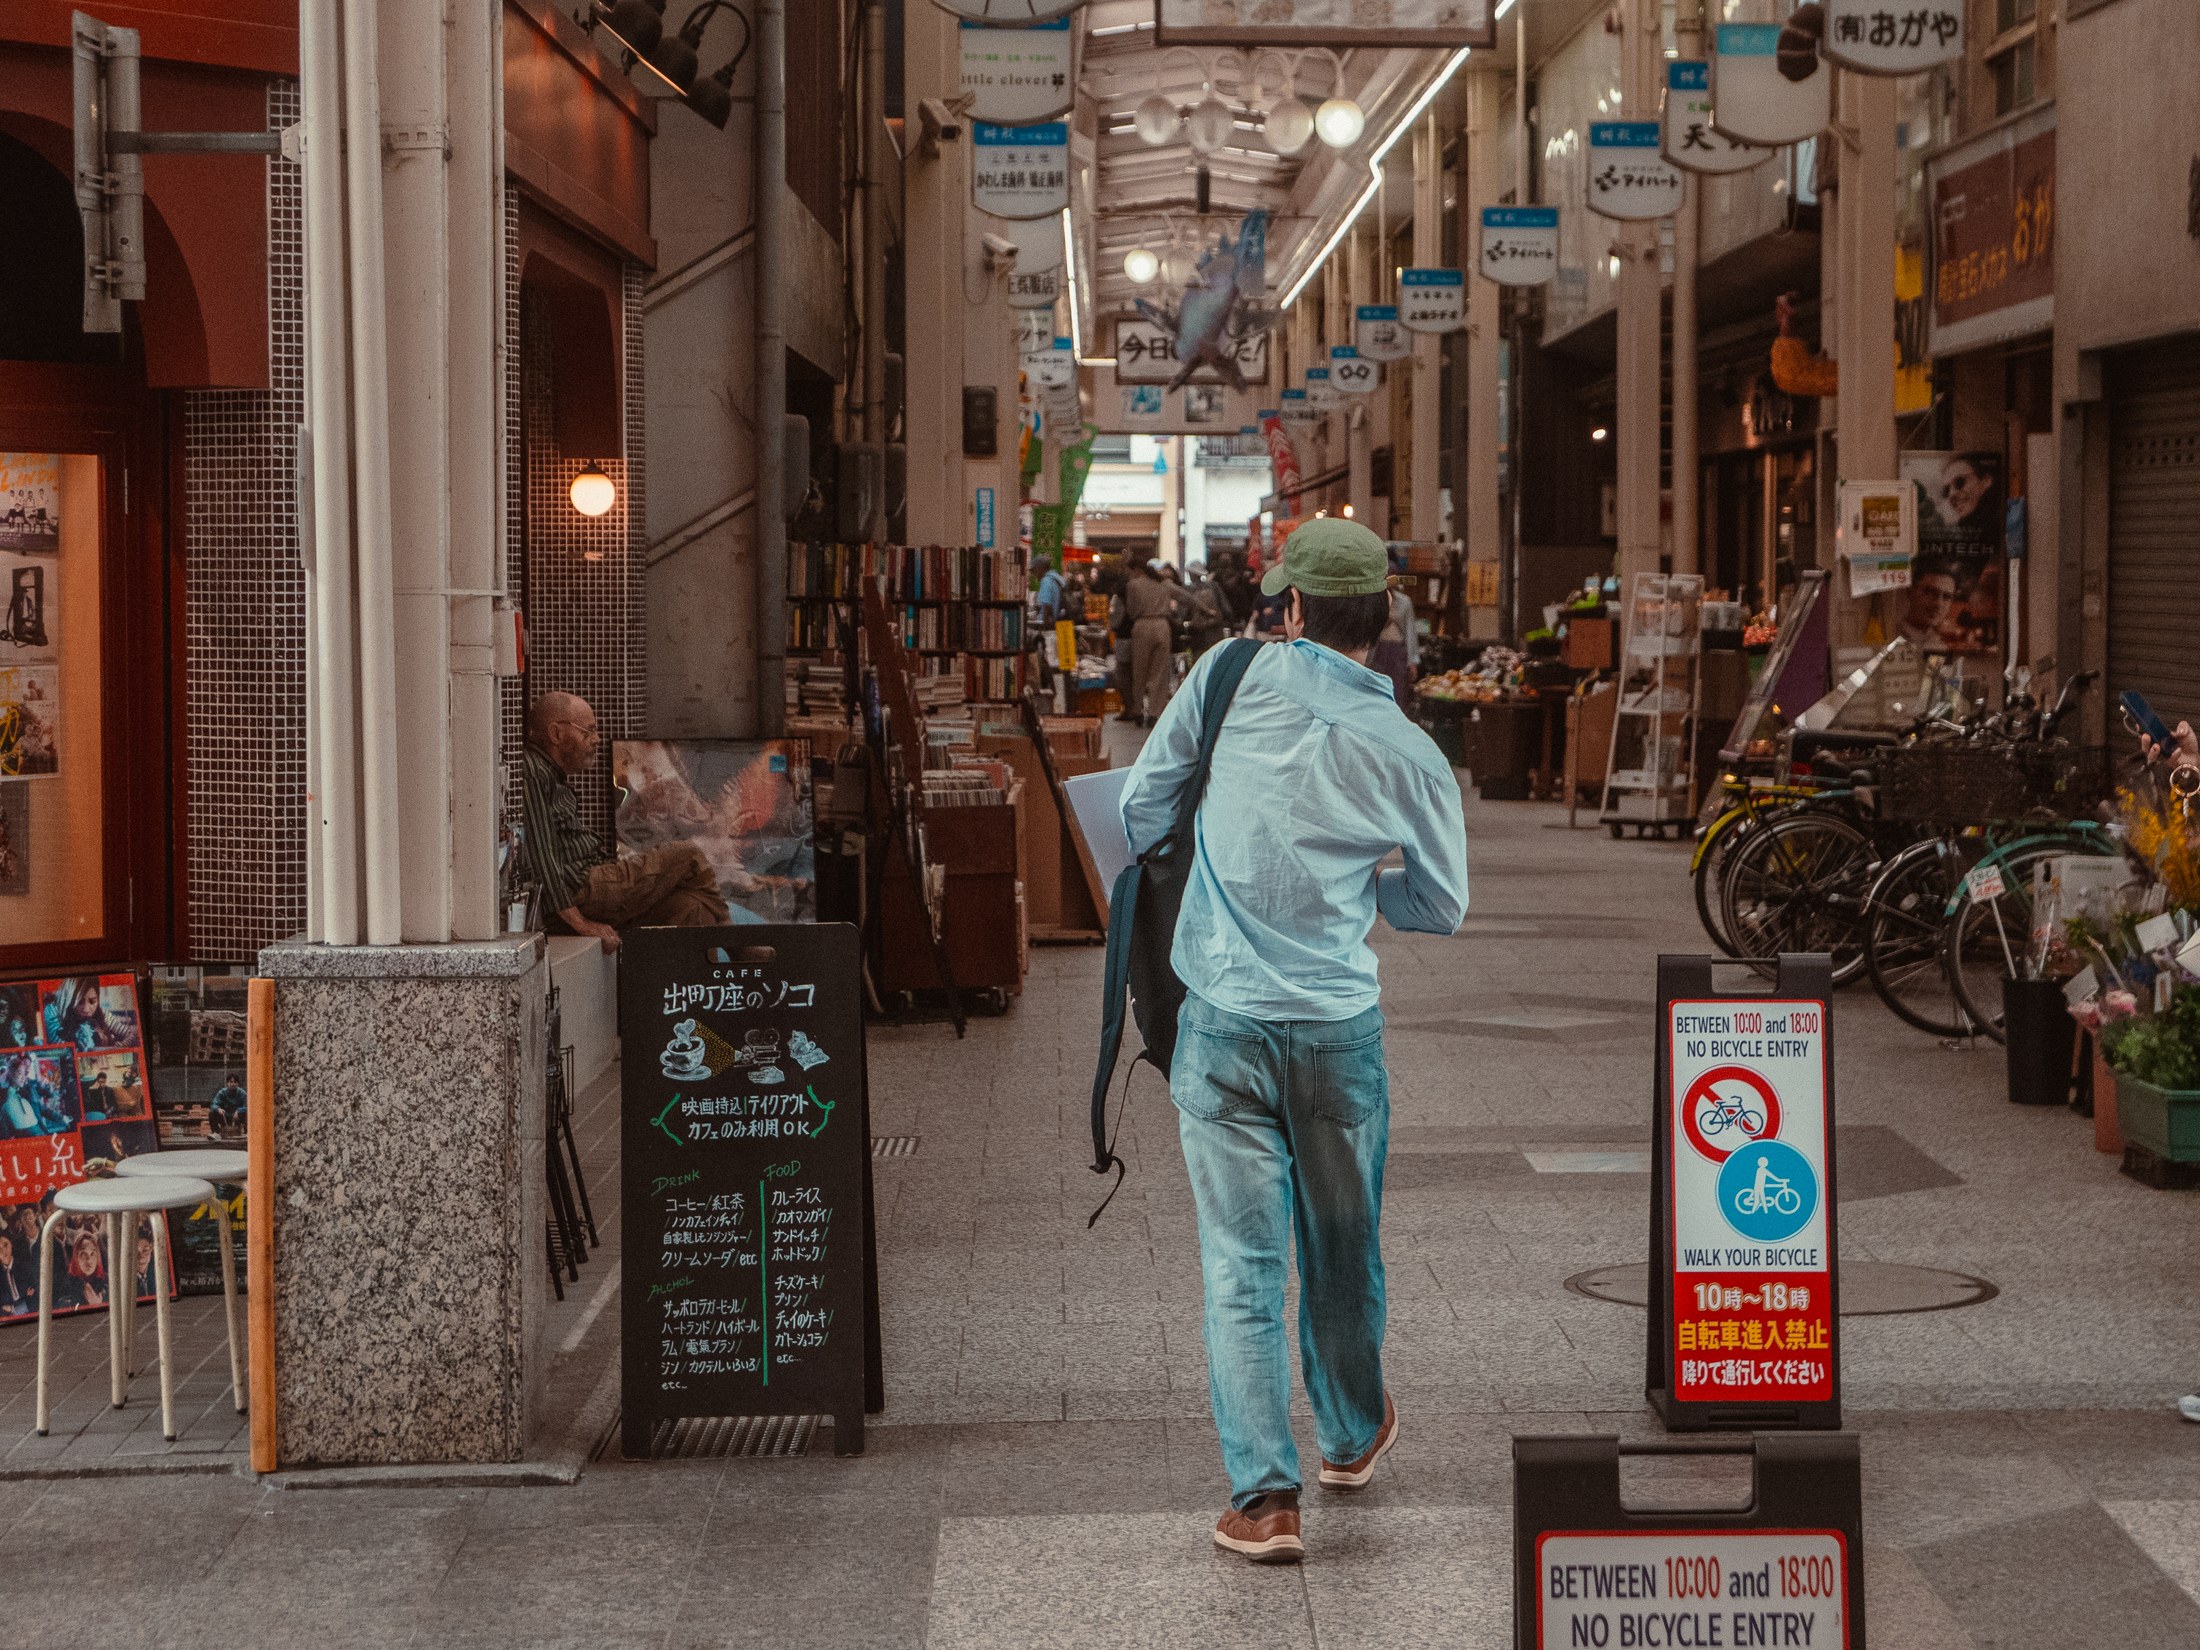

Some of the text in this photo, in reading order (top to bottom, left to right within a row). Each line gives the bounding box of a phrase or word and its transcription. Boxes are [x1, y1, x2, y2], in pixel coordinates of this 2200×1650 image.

[1000, 73, 1047, 85] clover
[1623, 173, 1679, 188] アイハート
[1881, 571, 1907, 584] 119
[713, 969, 762, 978] CAFE
[662, 980, 815, 1015] 出町座のソコ
[1676, 1011, 1819, 1035] BETWEEN 10:00 and 18:00
[1687, 1040, 1809, 1058] NO BICYCLE ENTRY
[748, 1094, 809, 1116] テイクアウト
[763, 1160, 801, 1182] FOOD
[651, 1170, 701, 1196] DRINK
[771, 1187, 822, 1207] カレーライス
[1684, 1248, 1818, 1266] WALK YOUR BICYCLE
[1678, 1318, 1829, 1352] 自転車進入禁止
[1681, 1357, 1825, 1388] 降りて通行してください
[1550, 1554, 1834, 1600] BETWEEN 10:00 and 18:00
[1571, 1612, 1815, 1648] NO BICYCLE ENTRY
